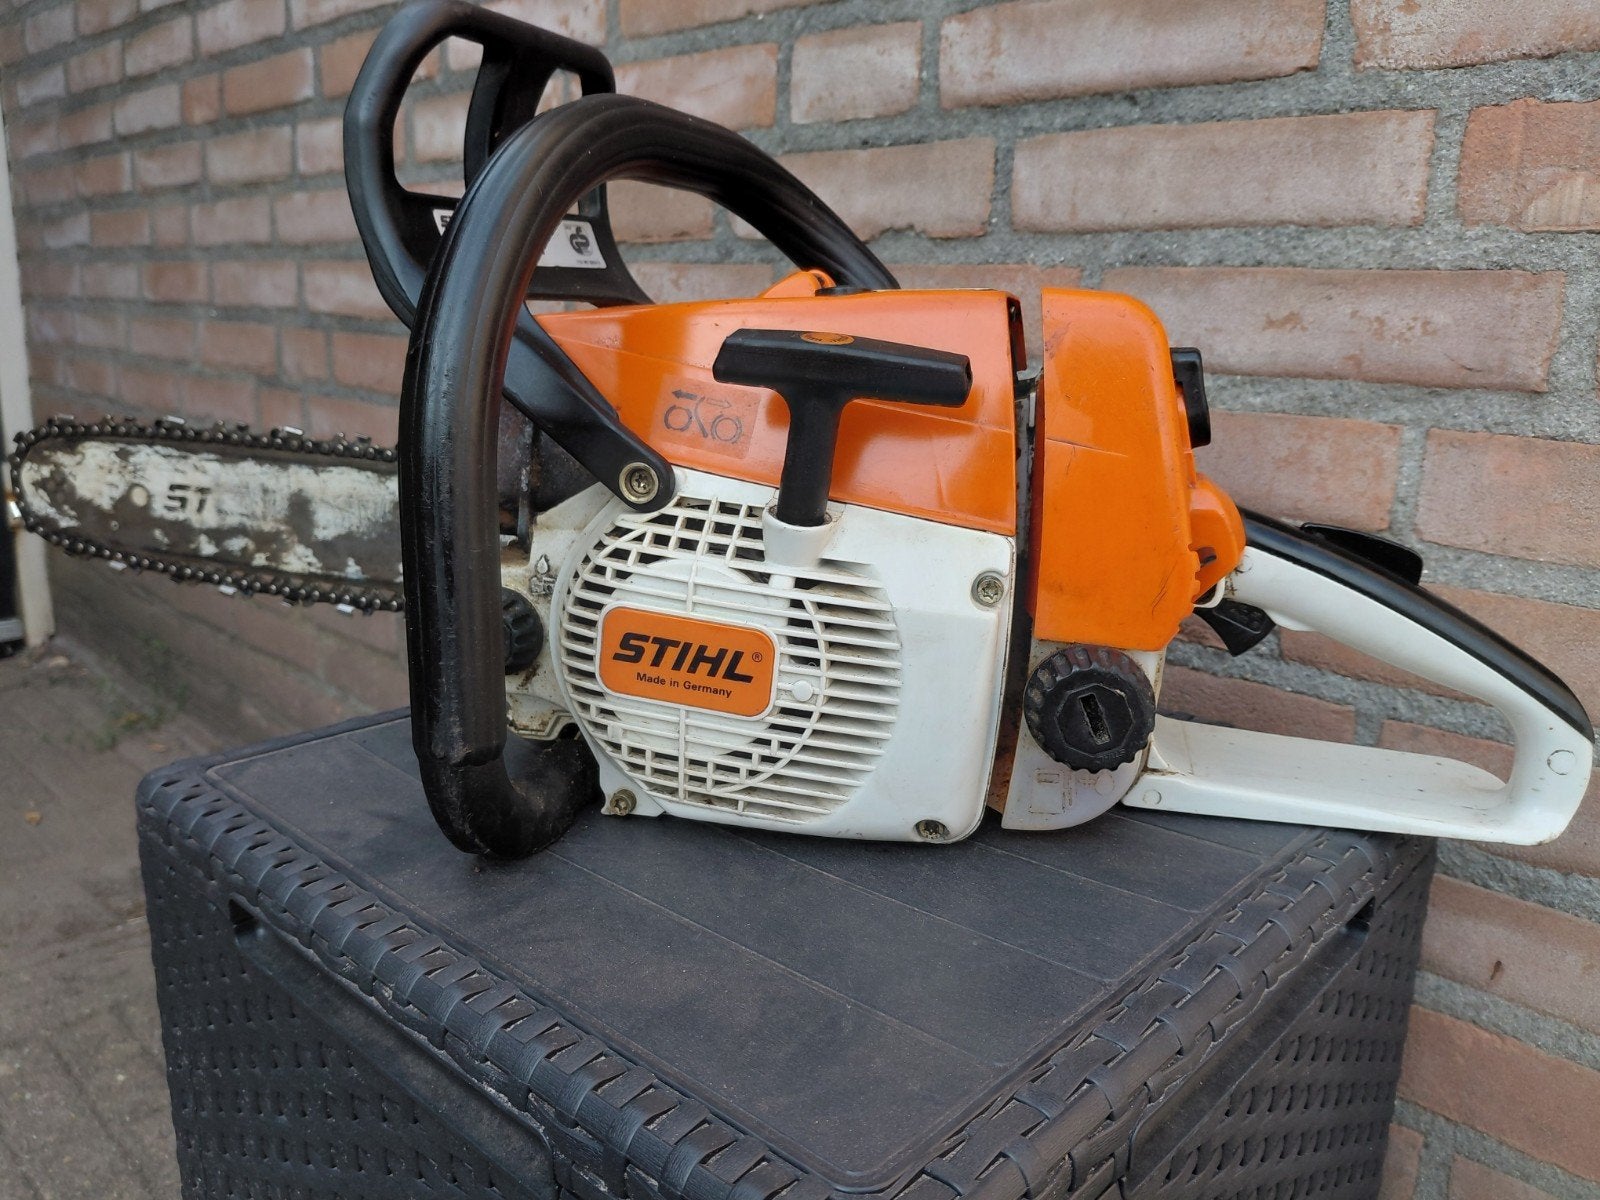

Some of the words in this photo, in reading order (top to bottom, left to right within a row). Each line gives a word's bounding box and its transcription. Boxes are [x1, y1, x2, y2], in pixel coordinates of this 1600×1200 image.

[612, 632, 754, 684] STIHL
[636, 672, 666, 686] Made
[669, 677, 679, 688] in
[683, 681, 732, 698] Germany
